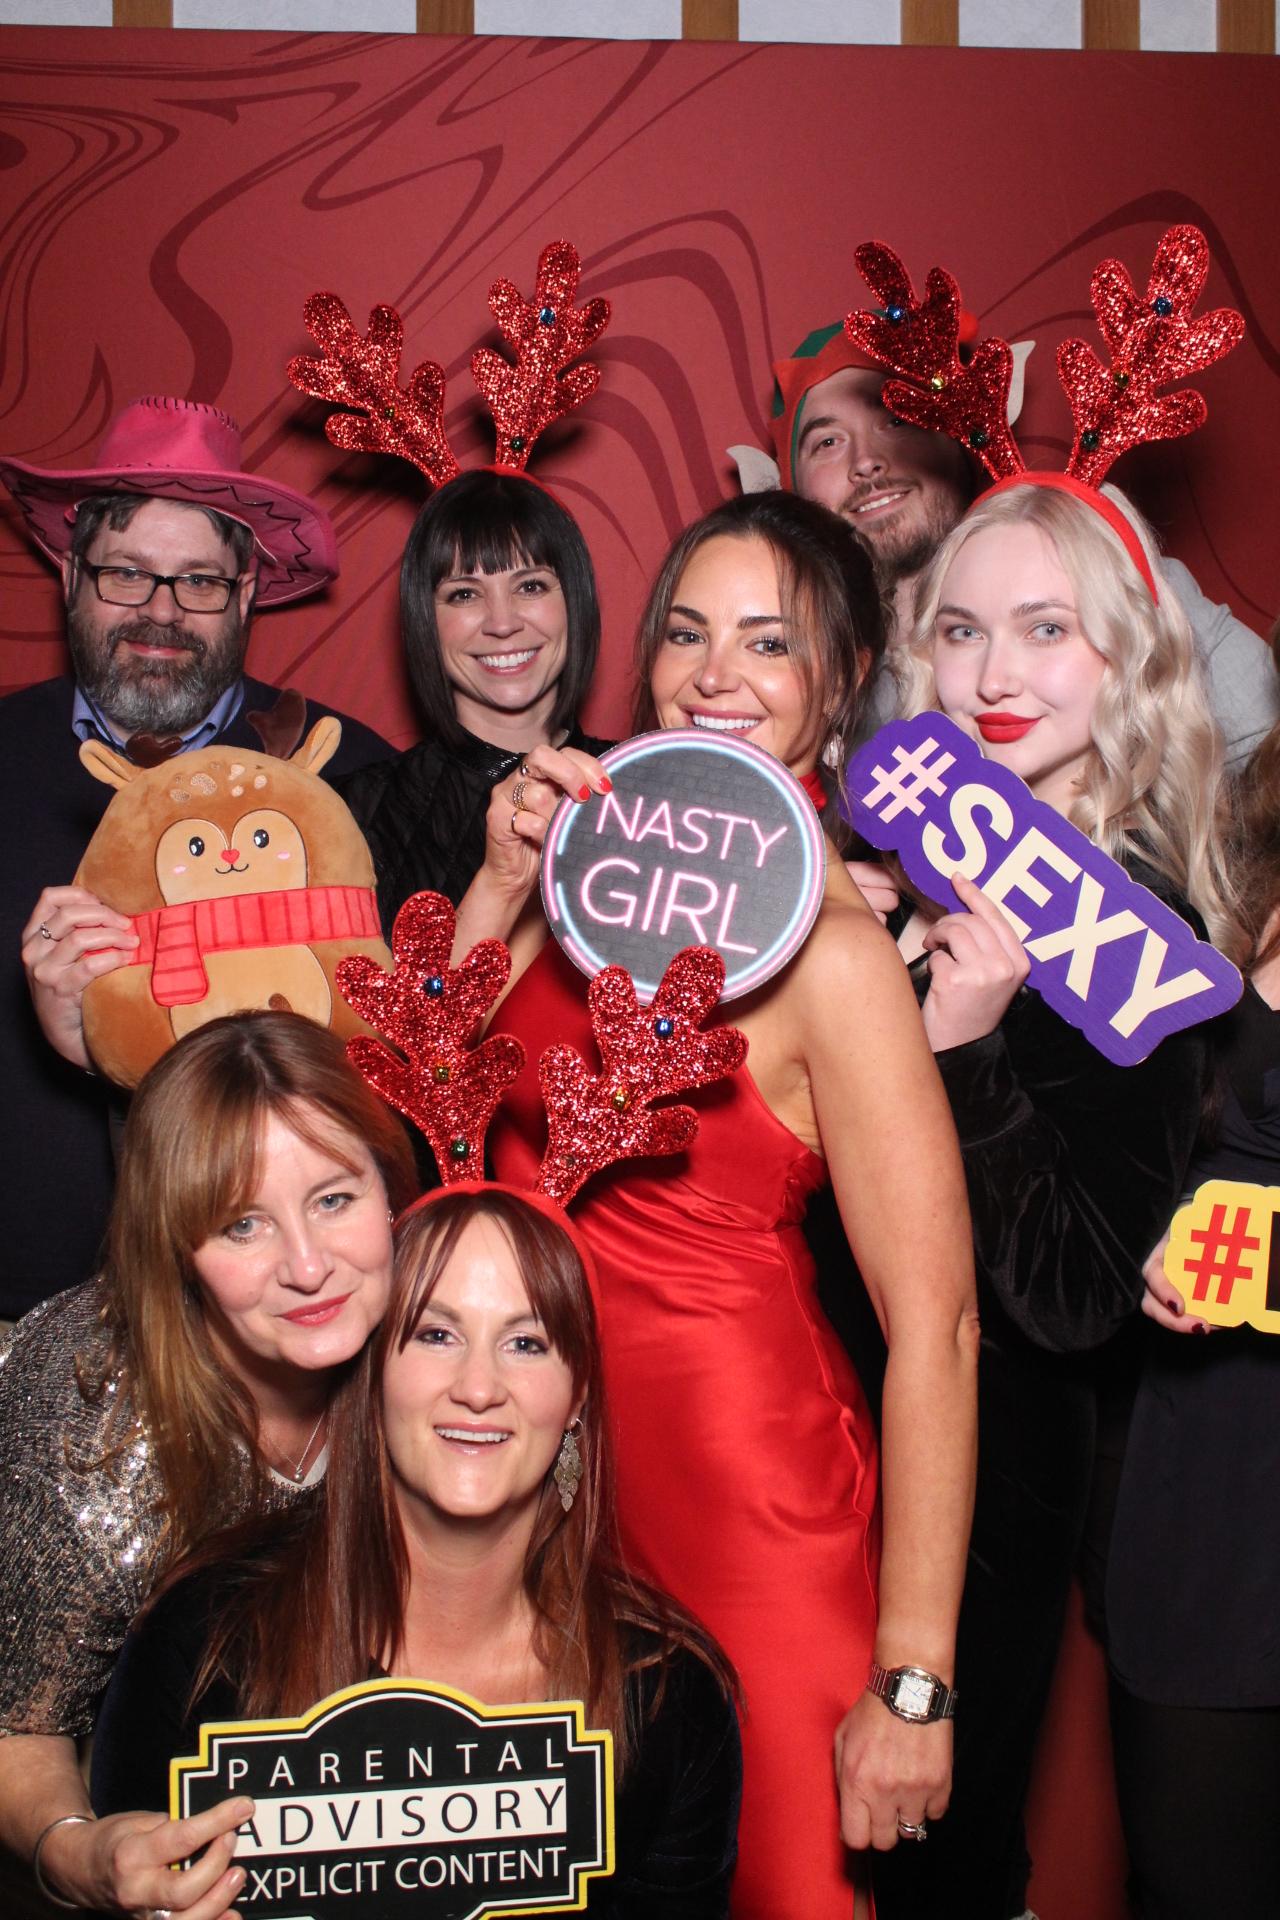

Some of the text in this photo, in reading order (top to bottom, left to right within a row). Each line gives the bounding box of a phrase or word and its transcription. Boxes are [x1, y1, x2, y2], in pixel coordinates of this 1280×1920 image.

[595, 790, 789, 868] NASTY
[580, 858, 758, 954] GIRL
[862, 736, 1216, 1040] #SEXY
[228, 1737, 565, 1790] PARENTAL
[235, 1846, 567, 1903] XPLICIT CONTENT
